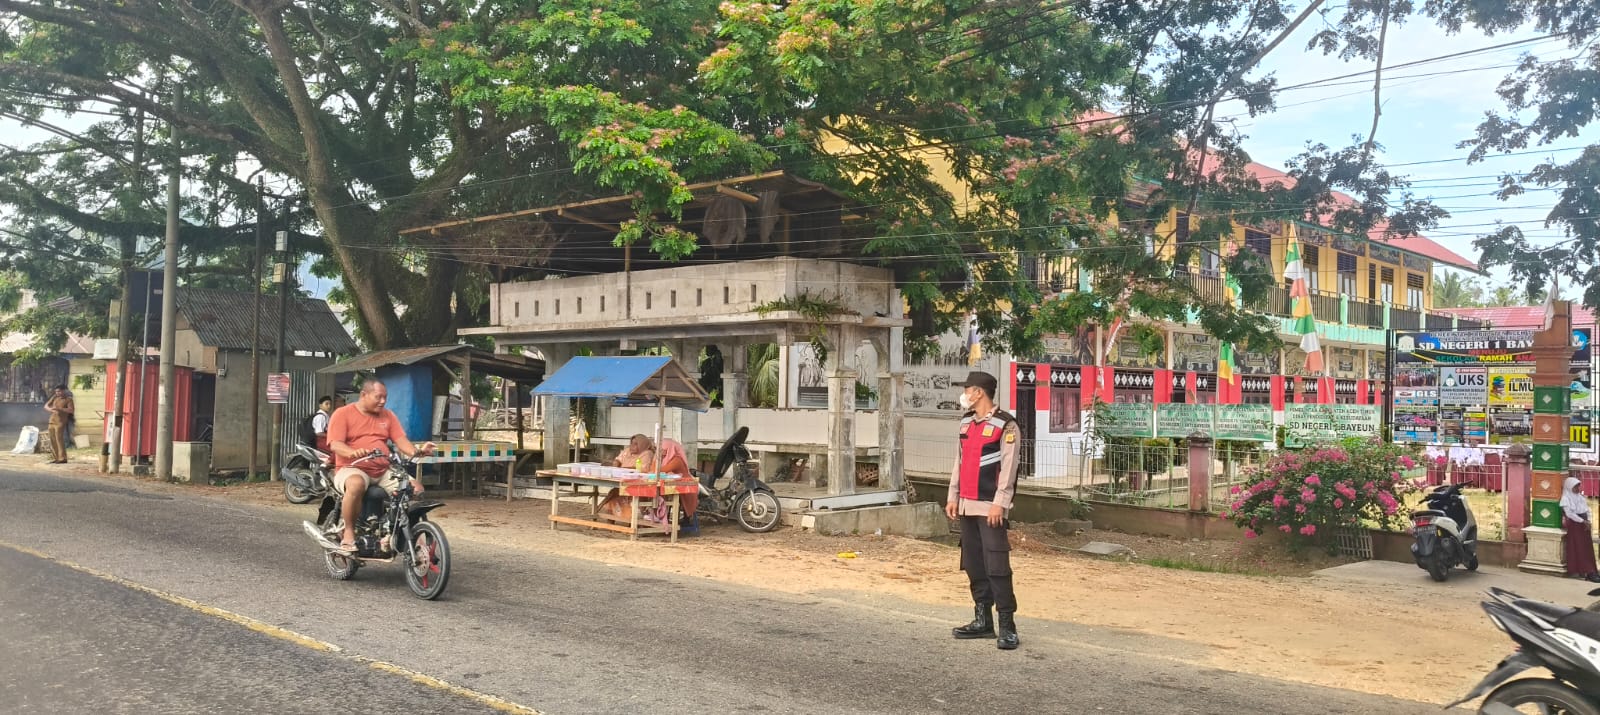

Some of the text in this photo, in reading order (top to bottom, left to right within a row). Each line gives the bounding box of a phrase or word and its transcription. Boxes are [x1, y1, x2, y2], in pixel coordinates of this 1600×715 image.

[1419, 342, 1435, 350] SD
[1440, 341, 1489, 350] NEGERI
[1494, 341, 1500, 349] 1
[1458, 374, 1484, 385] UKS
[1508, 383, 1535, 391] ILMU
[1290, 421, 1300, 430] SD
[1302, 422, 1332, 431] NEGERI
[1340, 423, 1375, 432] BAYEUN
